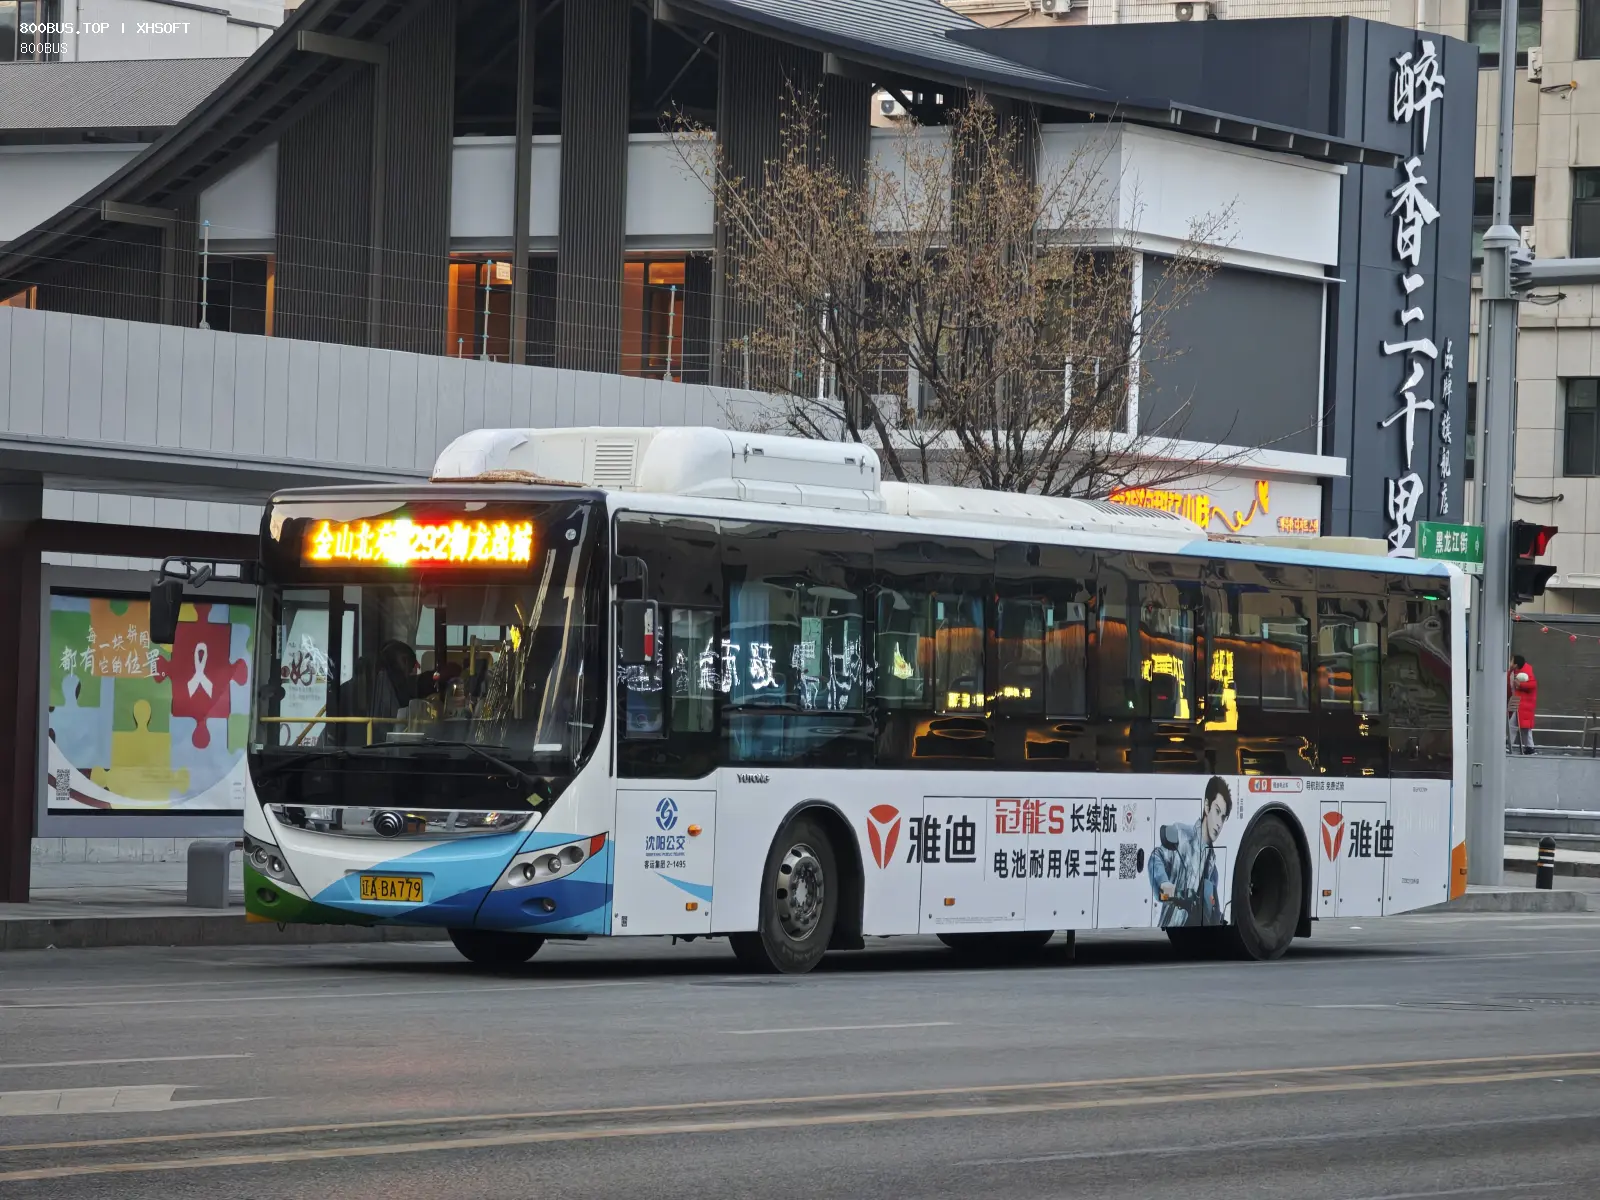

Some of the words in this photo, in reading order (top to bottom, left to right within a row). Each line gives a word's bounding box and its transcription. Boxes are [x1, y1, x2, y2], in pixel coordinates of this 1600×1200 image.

[1435, 530, 1468, 554] 黑龙江街
[86, 624, 150, 652] 每一块拼图
[995, 798, 1065, 835] 冠能S
[1070, 803, 1117, 833] 长续航
[645, 836, 686, 851] 沈阳公交
[906, 814, 977, 864] 雅迪
[1348, 820, 1394, 858] 雅迪
[644, 860, 666, 869] 客运集团
[667, 860, 686, 868] 2-1495
[993, 848, 1116, 879] 电池耐用保三年
